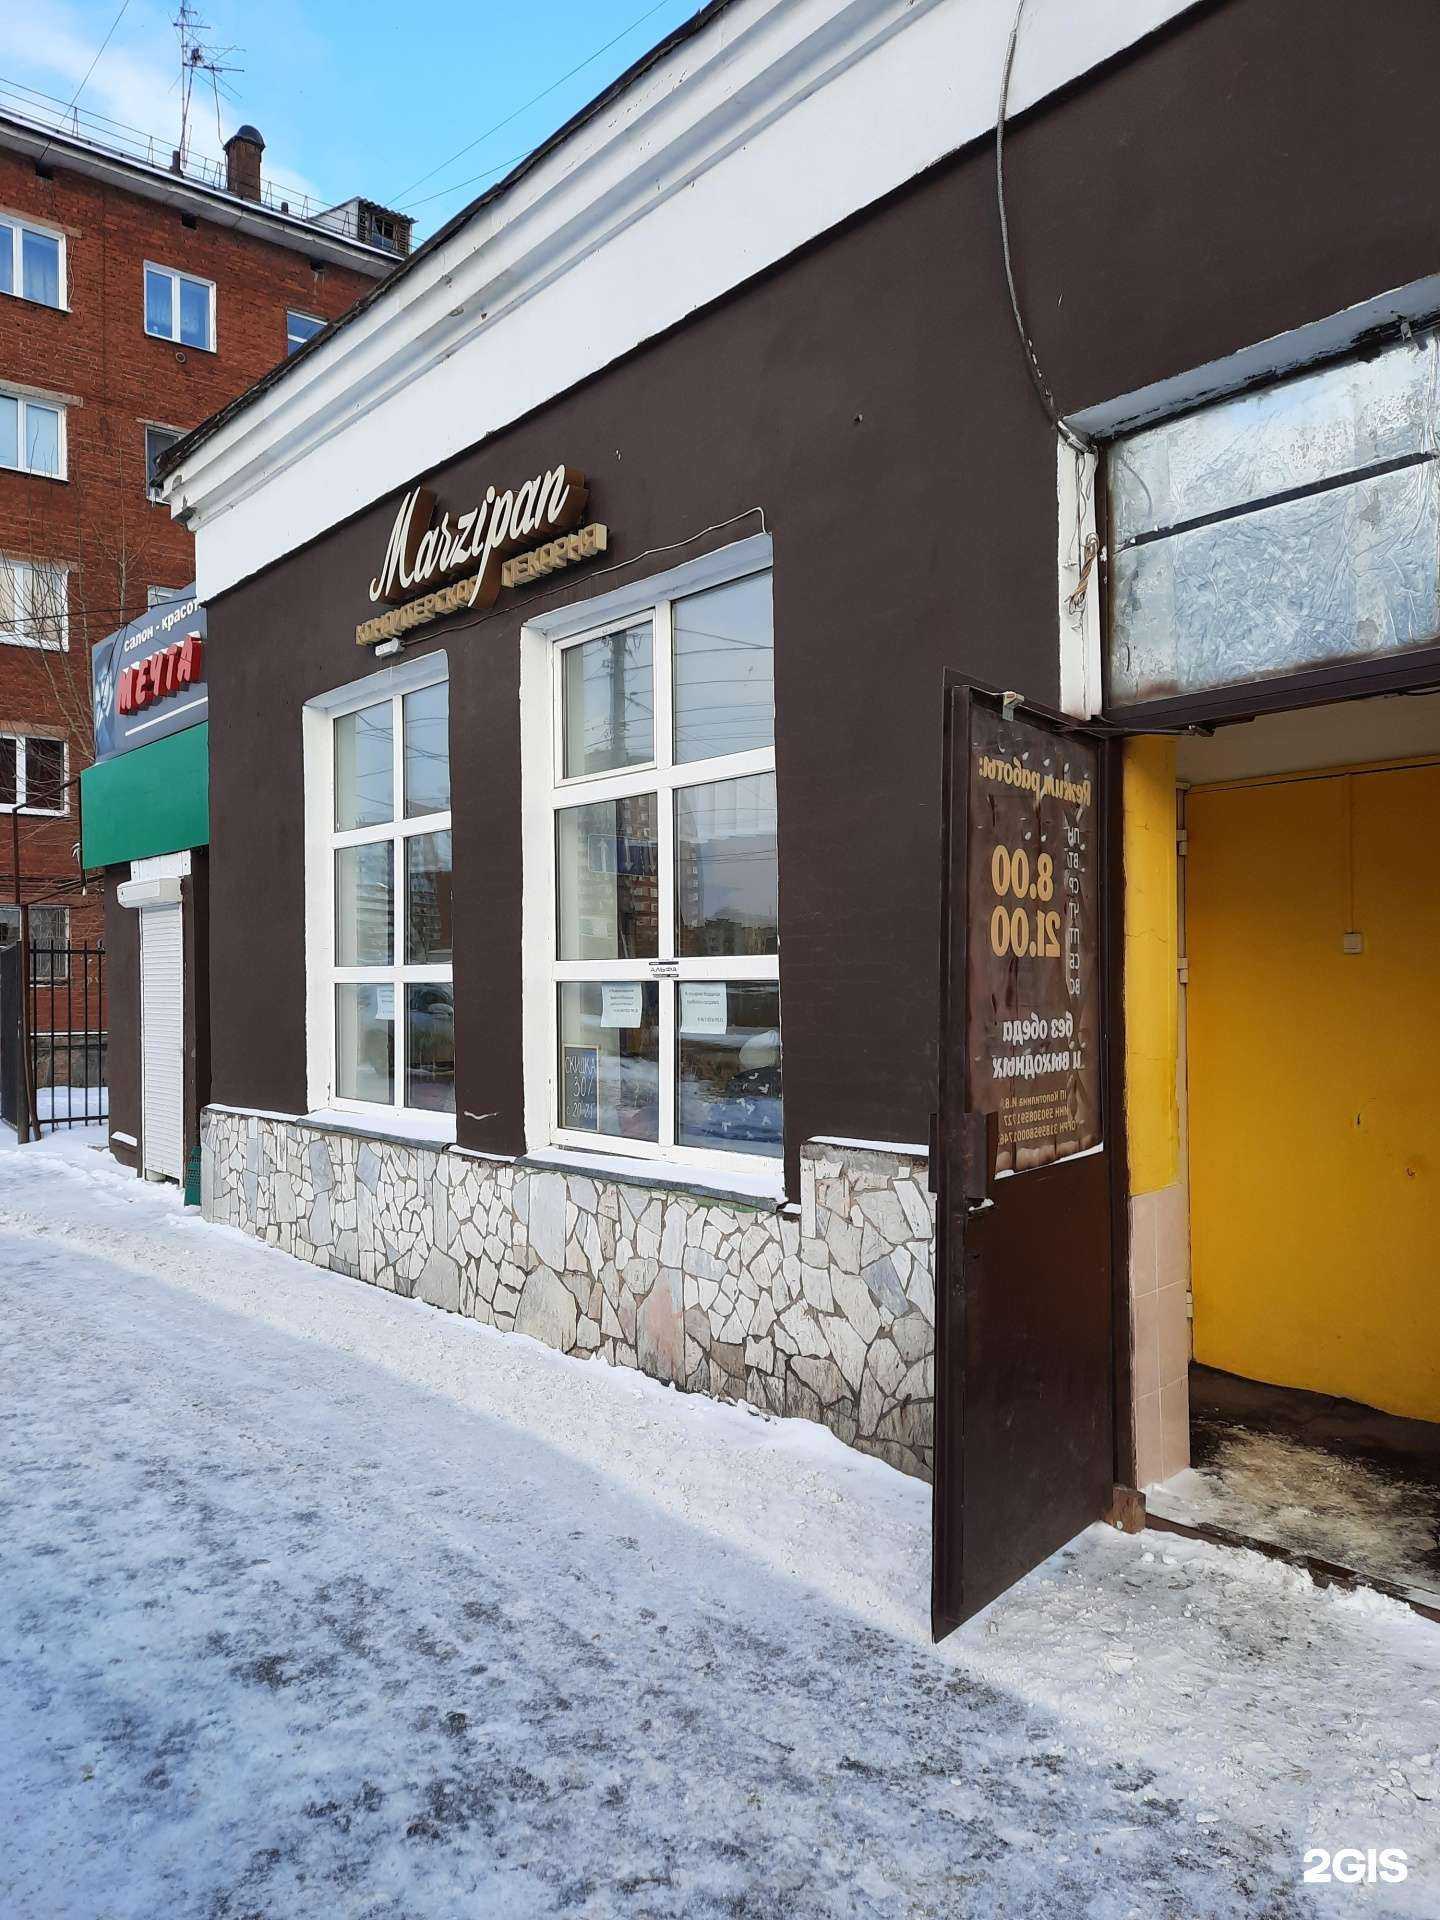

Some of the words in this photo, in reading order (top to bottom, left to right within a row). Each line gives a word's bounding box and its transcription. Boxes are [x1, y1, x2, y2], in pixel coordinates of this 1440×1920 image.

[369, 464, 570, 607] Marzipan
[502, 522, 608, 588] ПЕКАРНЯ
[124, 625, 154, 652] салон
[161, 599, 202, 632] красот
[118, 632, 202, 714] МЕЧТА
